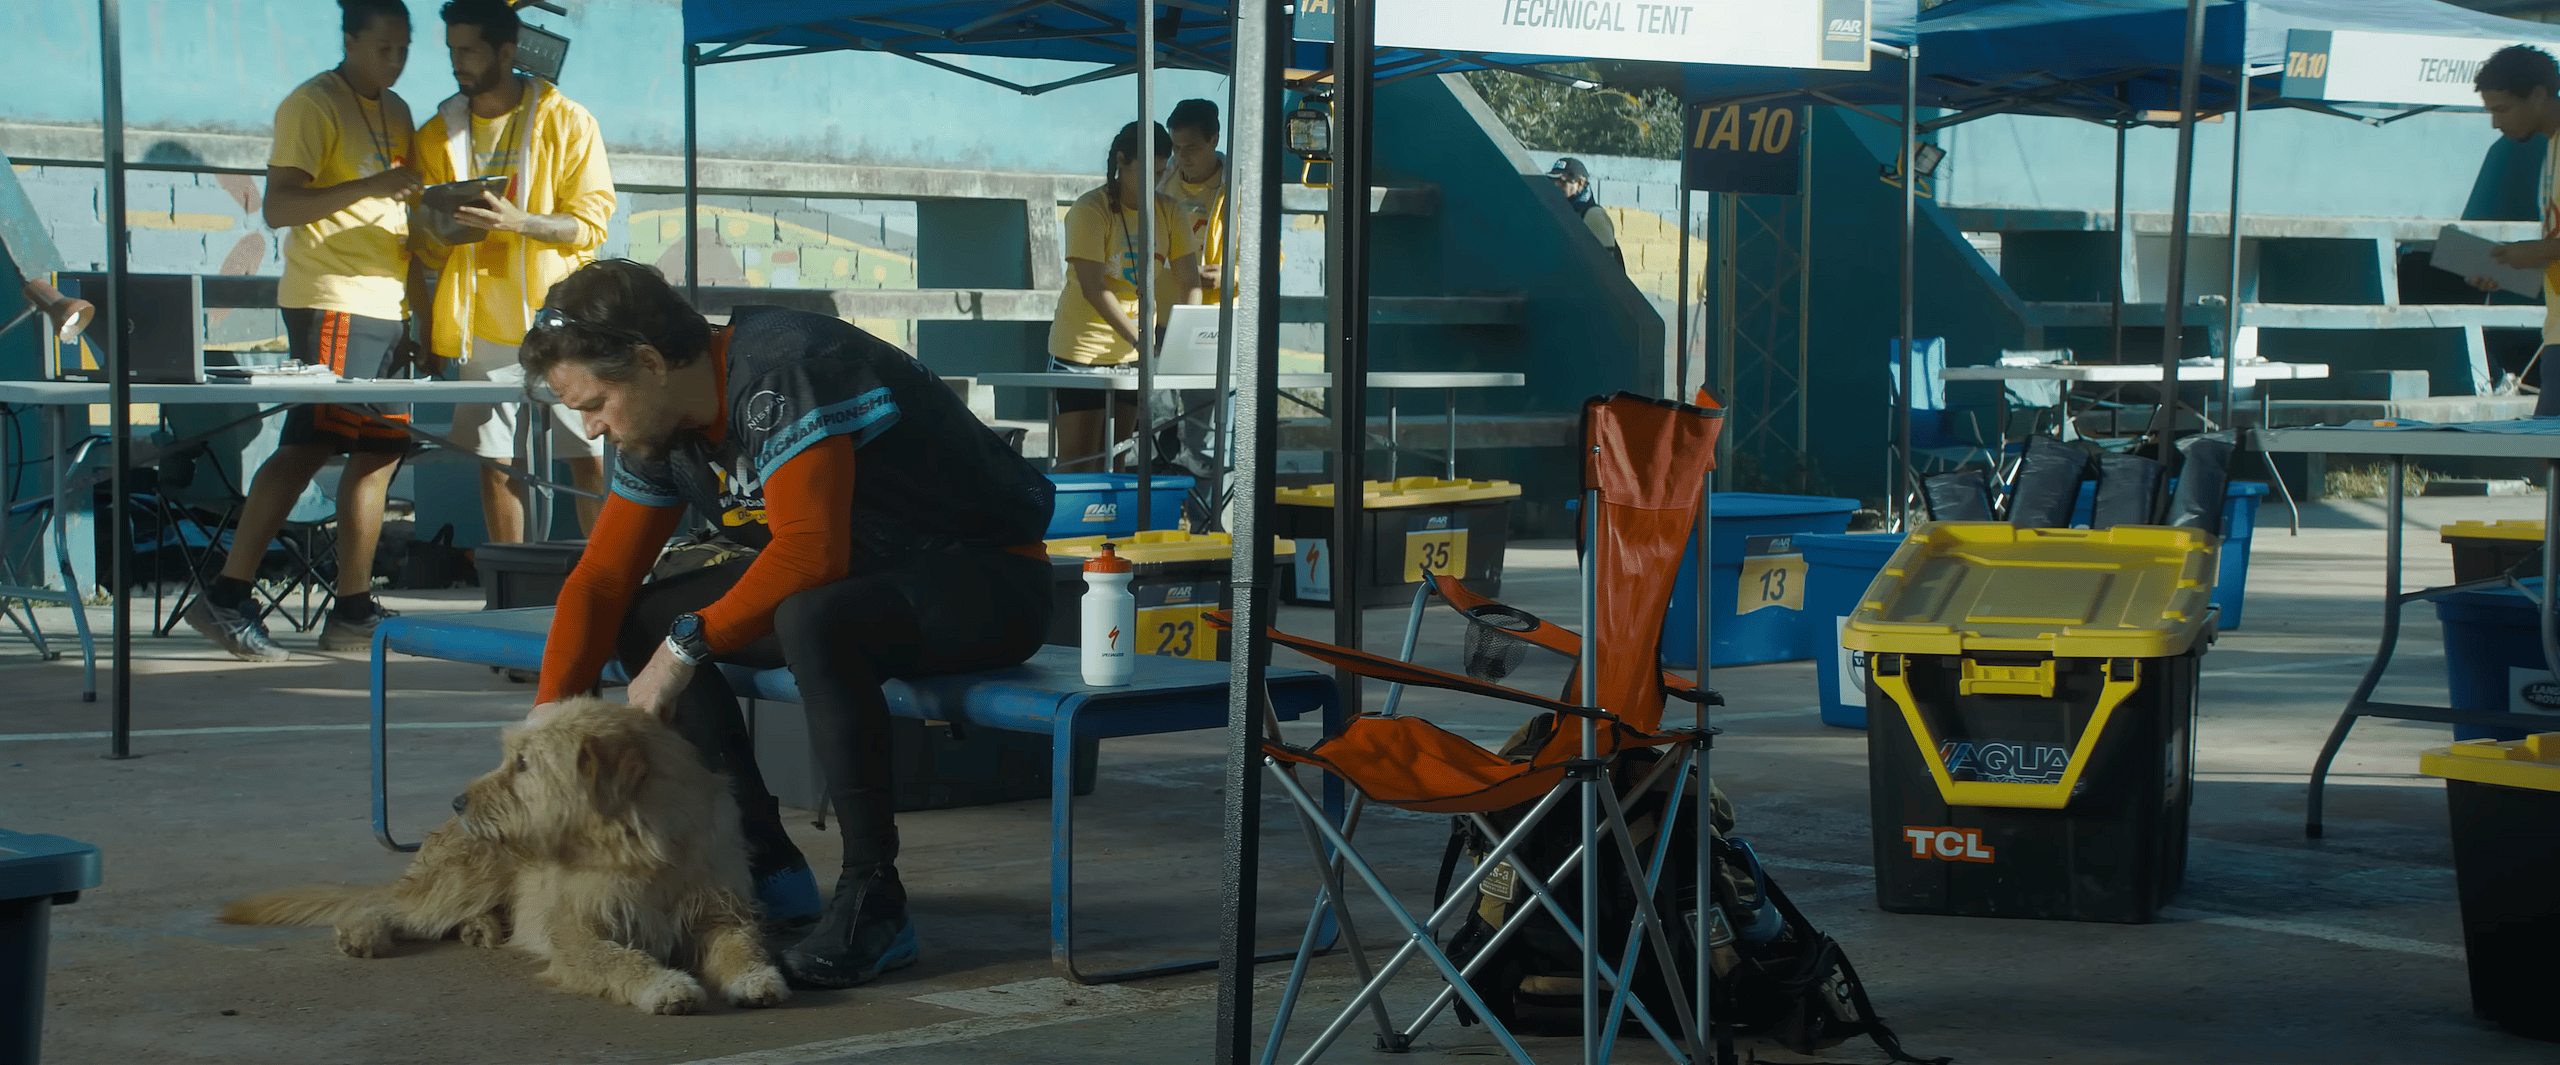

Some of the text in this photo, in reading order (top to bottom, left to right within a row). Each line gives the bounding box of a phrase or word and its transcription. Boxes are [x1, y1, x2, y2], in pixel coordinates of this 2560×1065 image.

[1502, 0, 1694, 36] TECHNICAL TENT
[2286, 51, 2328, 79] TA10
[1693, 105, 1794, 154] TA10
[748, 394, 786, 431] NISSAN
[1419, 541, 1450, 569] 35
[1759, 567, 1787, 602] 13
[1155, 620, 1195, 657] 23
[1950, 742, 2071, 778] AQUA
[1906, 828, 1990, 859] TCL
